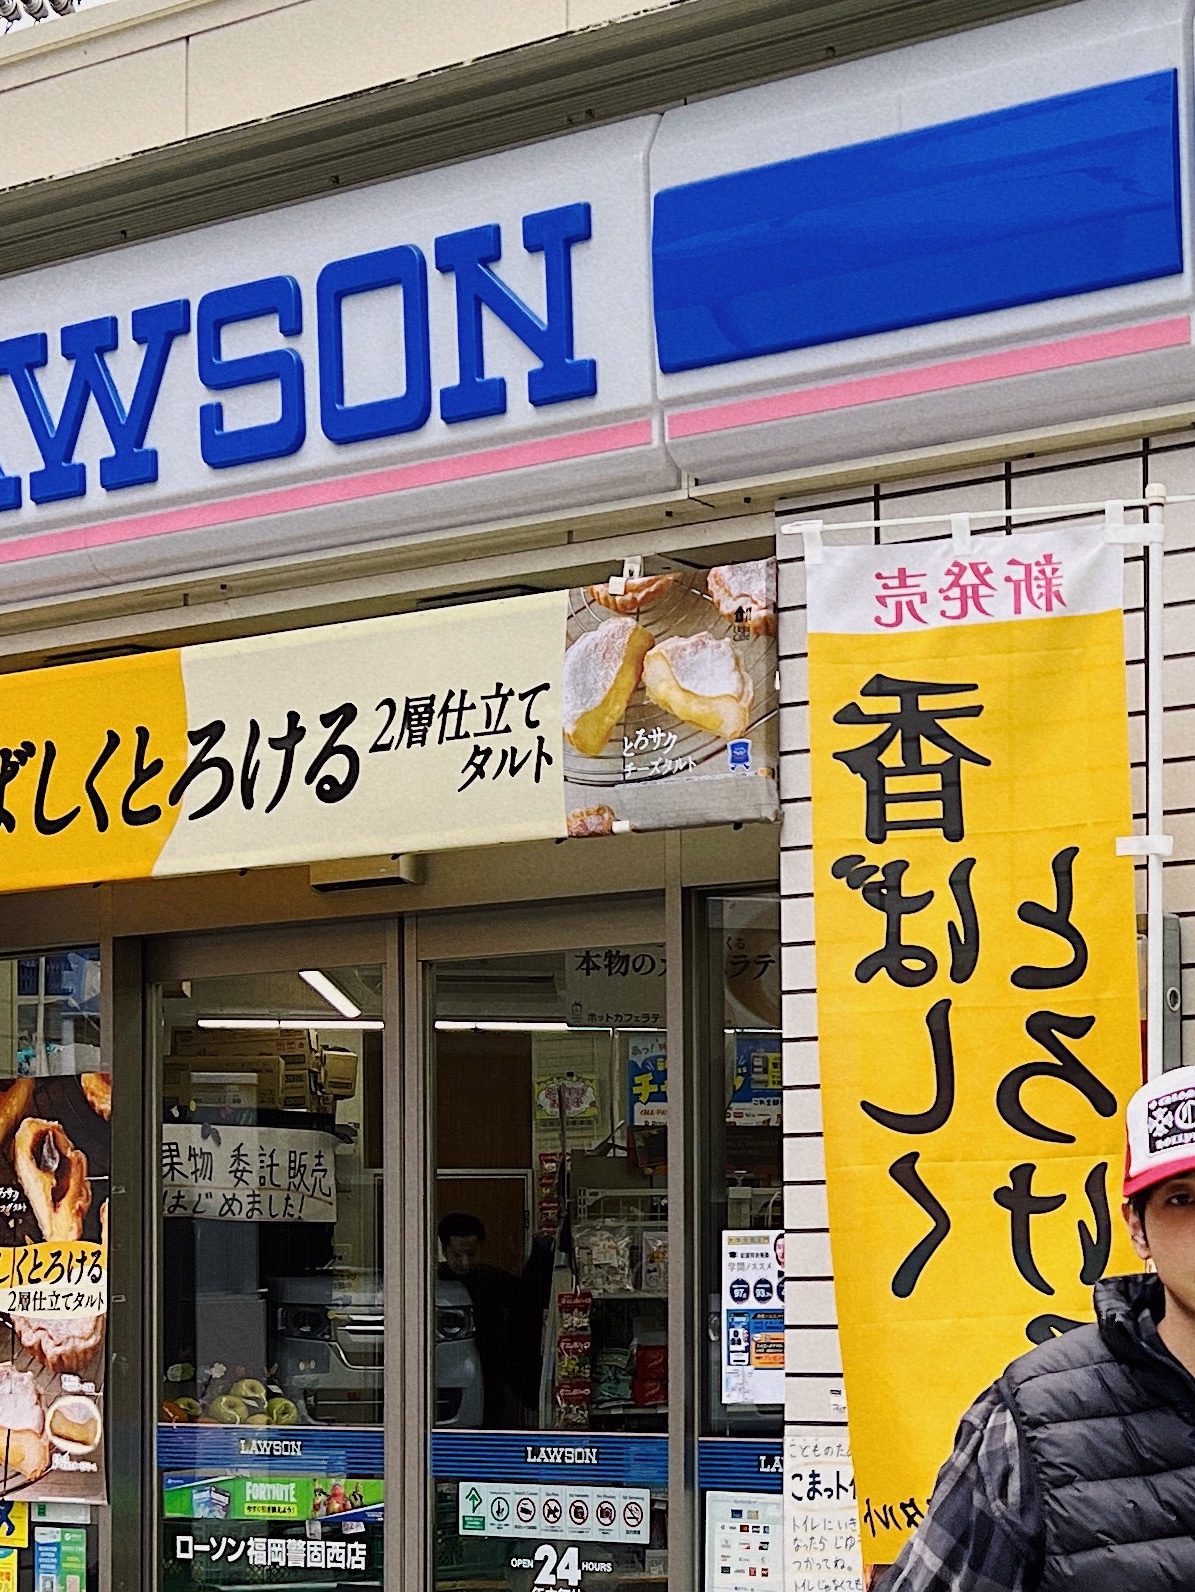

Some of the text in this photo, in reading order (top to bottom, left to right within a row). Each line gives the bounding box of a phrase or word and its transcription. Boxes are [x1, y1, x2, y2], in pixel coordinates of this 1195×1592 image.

[368, 681, 551, 754] 2層仕立て
[622, 727, 678, 757] とろサク
[457, 736, 554, 793] タルト
[623, 755, 697, 778] チーズタルト
[228, 1142, 332, 1198] 委託販売
[8, 1290, 105, 1312] 2層仕立てタルト
[240, 1440, 302, 1456] LAWSON
[526, 1447, 598, 1464] LAWSON
[245, 1481, 297, 1502] FORTNITE
[175, 1535, 367, 1571] ローソン福岡警固西店
[510, 1543, 613, 1587] OPEN 24 HOURS
